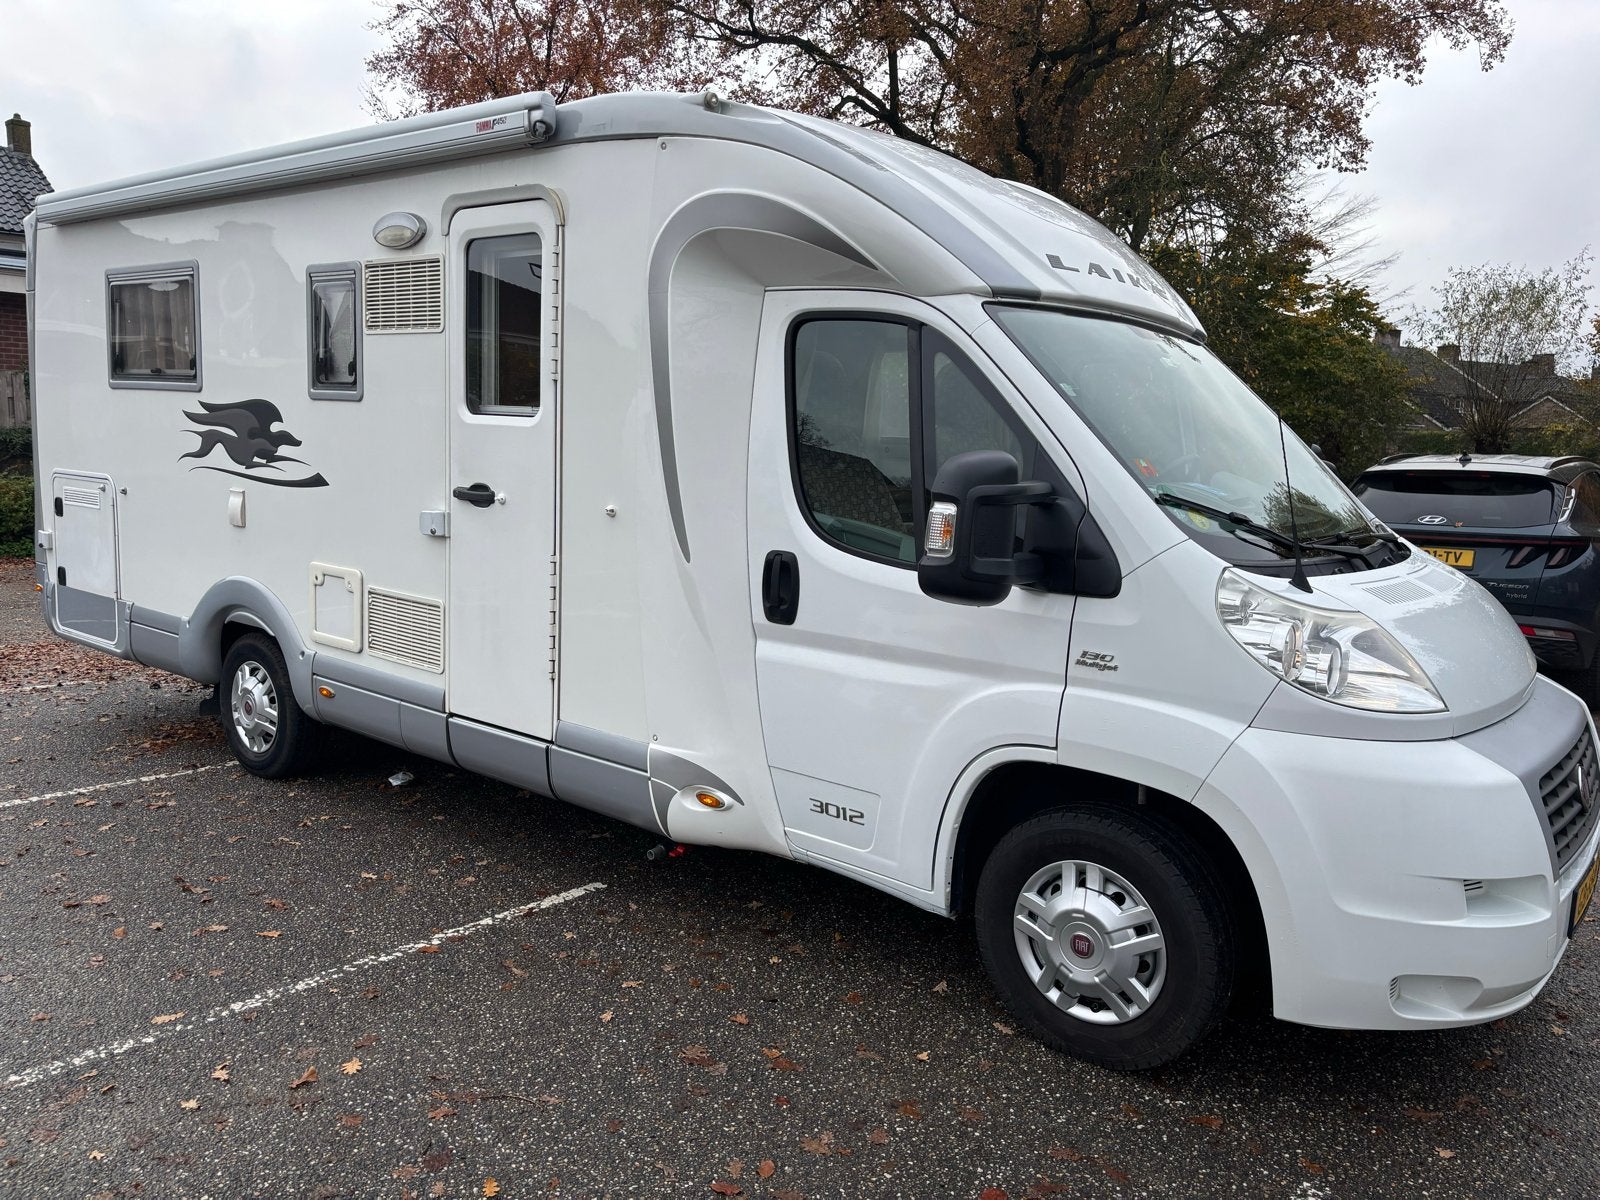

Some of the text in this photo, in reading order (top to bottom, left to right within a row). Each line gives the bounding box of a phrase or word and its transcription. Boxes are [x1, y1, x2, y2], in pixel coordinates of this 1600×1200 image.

[1080, 650, 1114, 662] 130
[809, 797, 865, 826] 3012
[1075, 939, 1089, 953] FIAT
